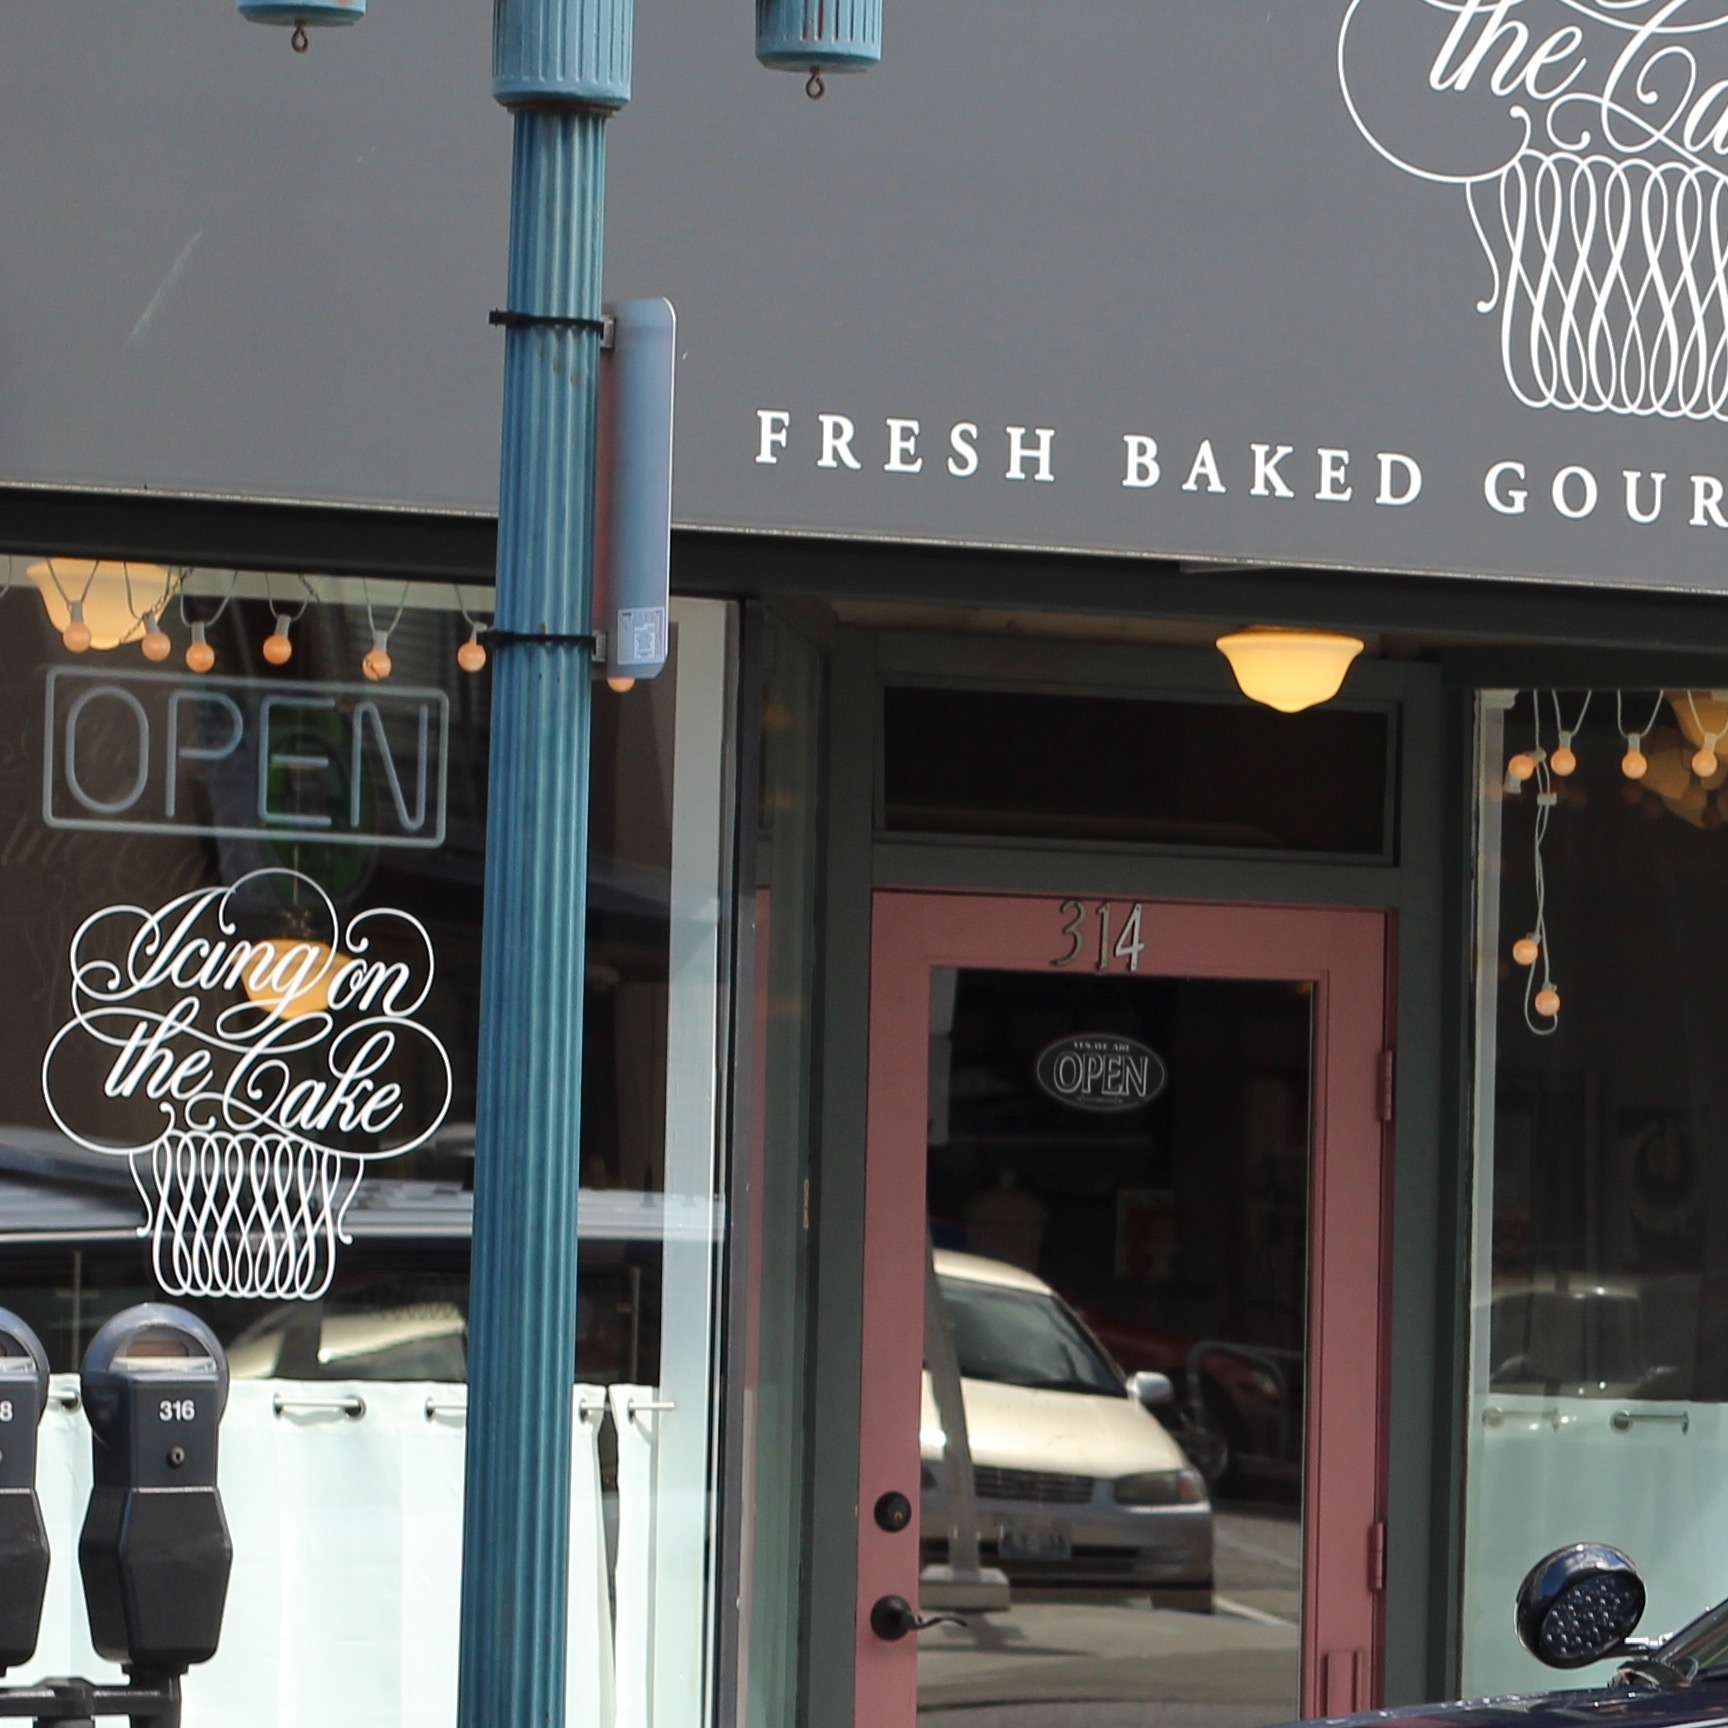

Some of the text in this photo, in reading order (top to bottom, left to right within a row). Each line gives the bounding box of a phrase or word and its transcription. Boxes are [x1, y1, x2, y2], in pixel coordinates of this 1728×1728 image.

[1429, 0, 1588, 100] the
[755, 410, 1055, 482] FRESH
[1122, 435, 1422, 505] BAKED
[64, 686, 429, 832] OPEN
[90, 880, 420, 1040] Icing on
[1052, 899, 1145, 974] 314
[104, 996, 404, 1133] the Cake
[1053, 1051, 1148, 1097] OPEN
[0, 1400, 13, 1422] 8
[159, 1400, 195, 1421] 316
